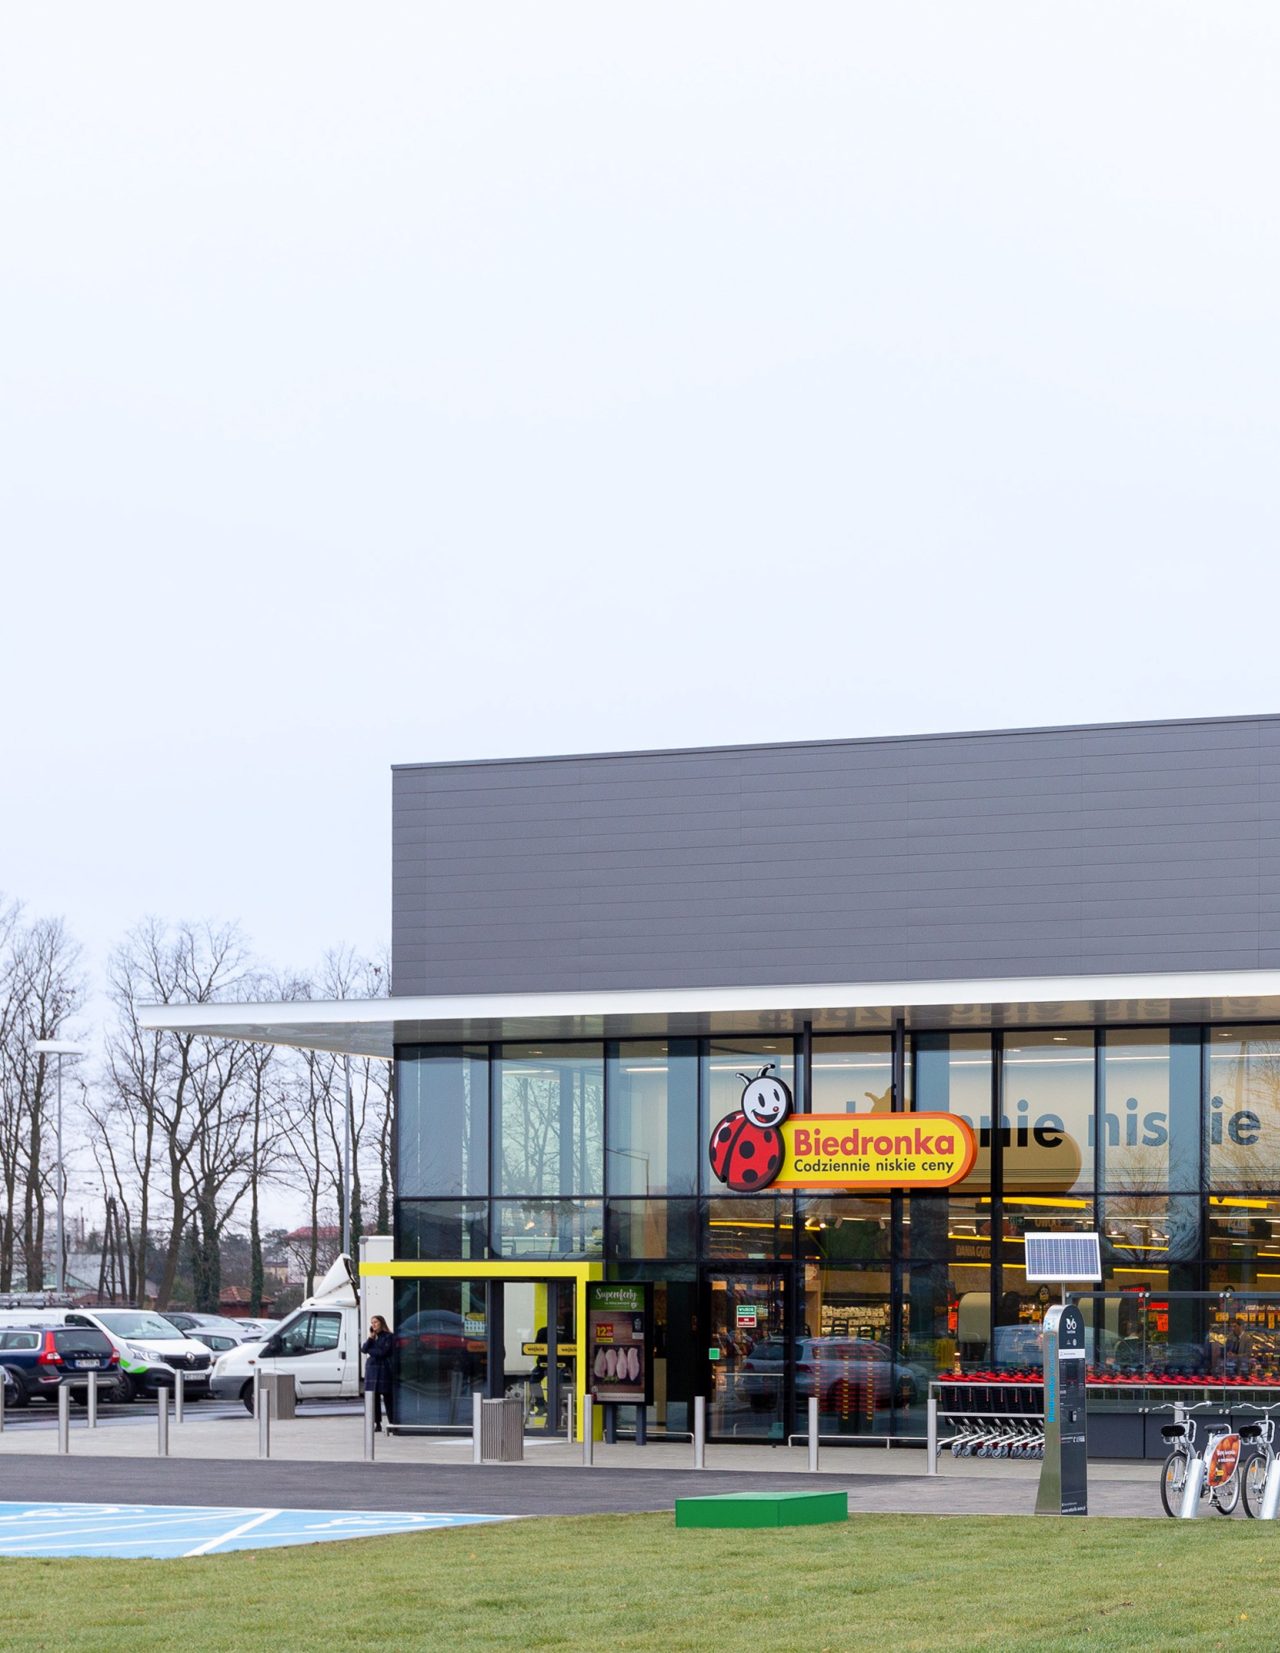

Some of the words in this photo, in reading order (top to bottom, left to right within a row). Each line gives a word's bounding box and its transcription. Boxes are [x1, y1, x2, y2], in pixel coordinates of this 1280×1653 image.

[1088, 1096, 1262, 1147] nisie
[794, 1128, 954, 1157] Biedronka
[794, 1158, 871, 1173] Codziennie
[876, 1158, 916, 1172] niskie
[921, 1161, 954, 1174] ceny
